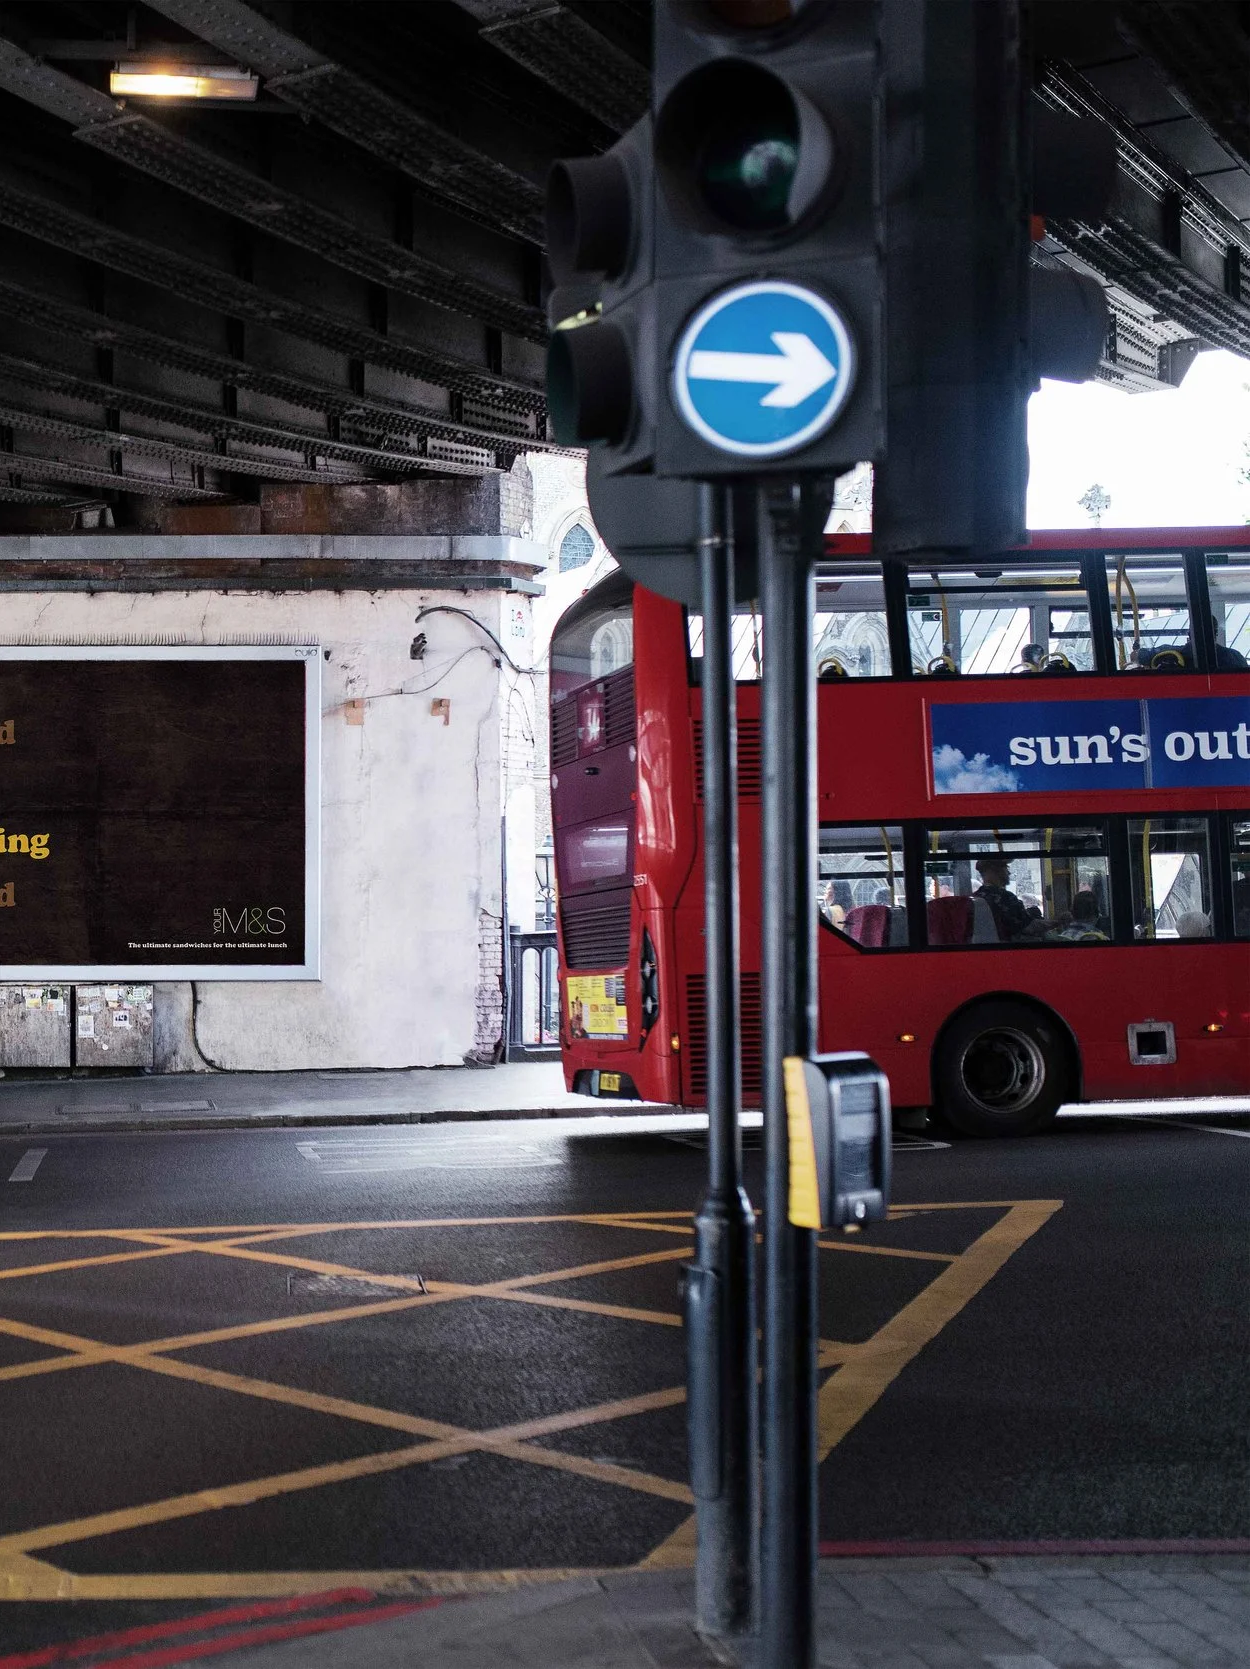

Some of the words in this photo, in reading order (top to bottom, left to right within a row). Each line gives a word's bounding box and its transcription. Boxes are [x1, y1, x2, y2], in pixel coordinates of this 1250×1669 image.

[1164, 723, 1250, 762] out
[213, 908, 222, 935] YOUR
[222, 907, 286, 935] M&S
